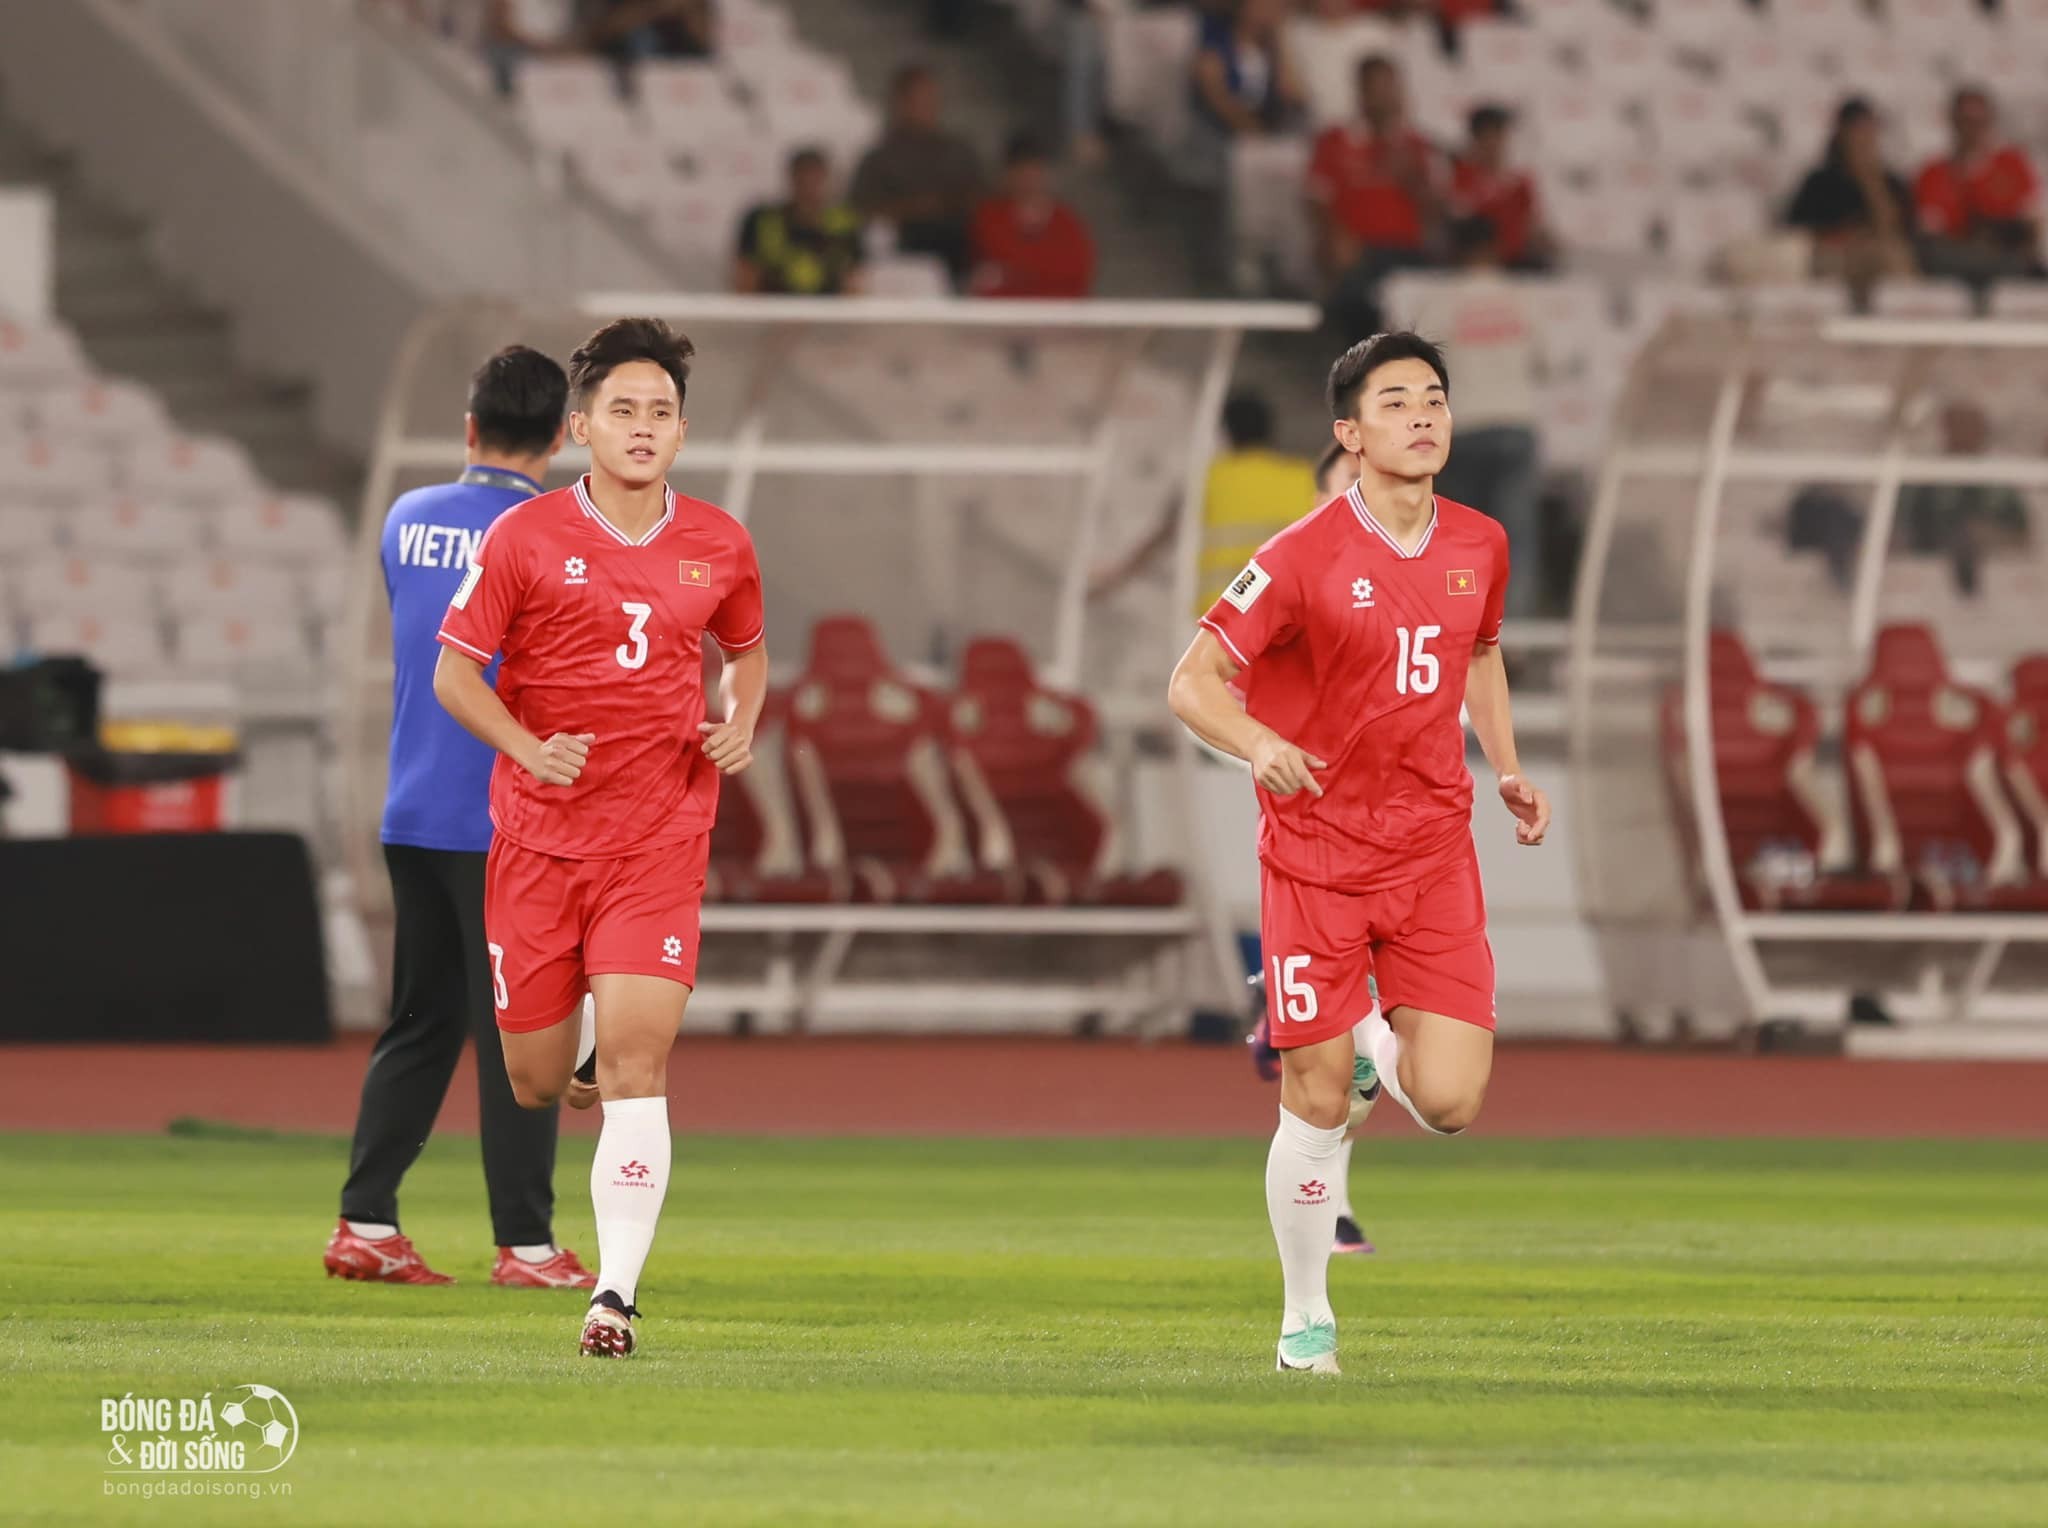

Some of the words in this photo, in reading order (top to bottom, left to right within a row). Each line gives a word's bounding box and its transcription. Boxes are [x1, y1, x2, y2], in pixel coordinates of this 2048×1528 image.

[615, 601, 652, 669] 3
[1395, 624, 1442, 695] 15
[488, 942, 510, 1011] 3
[1271, 954, 1319, 1024] 15
